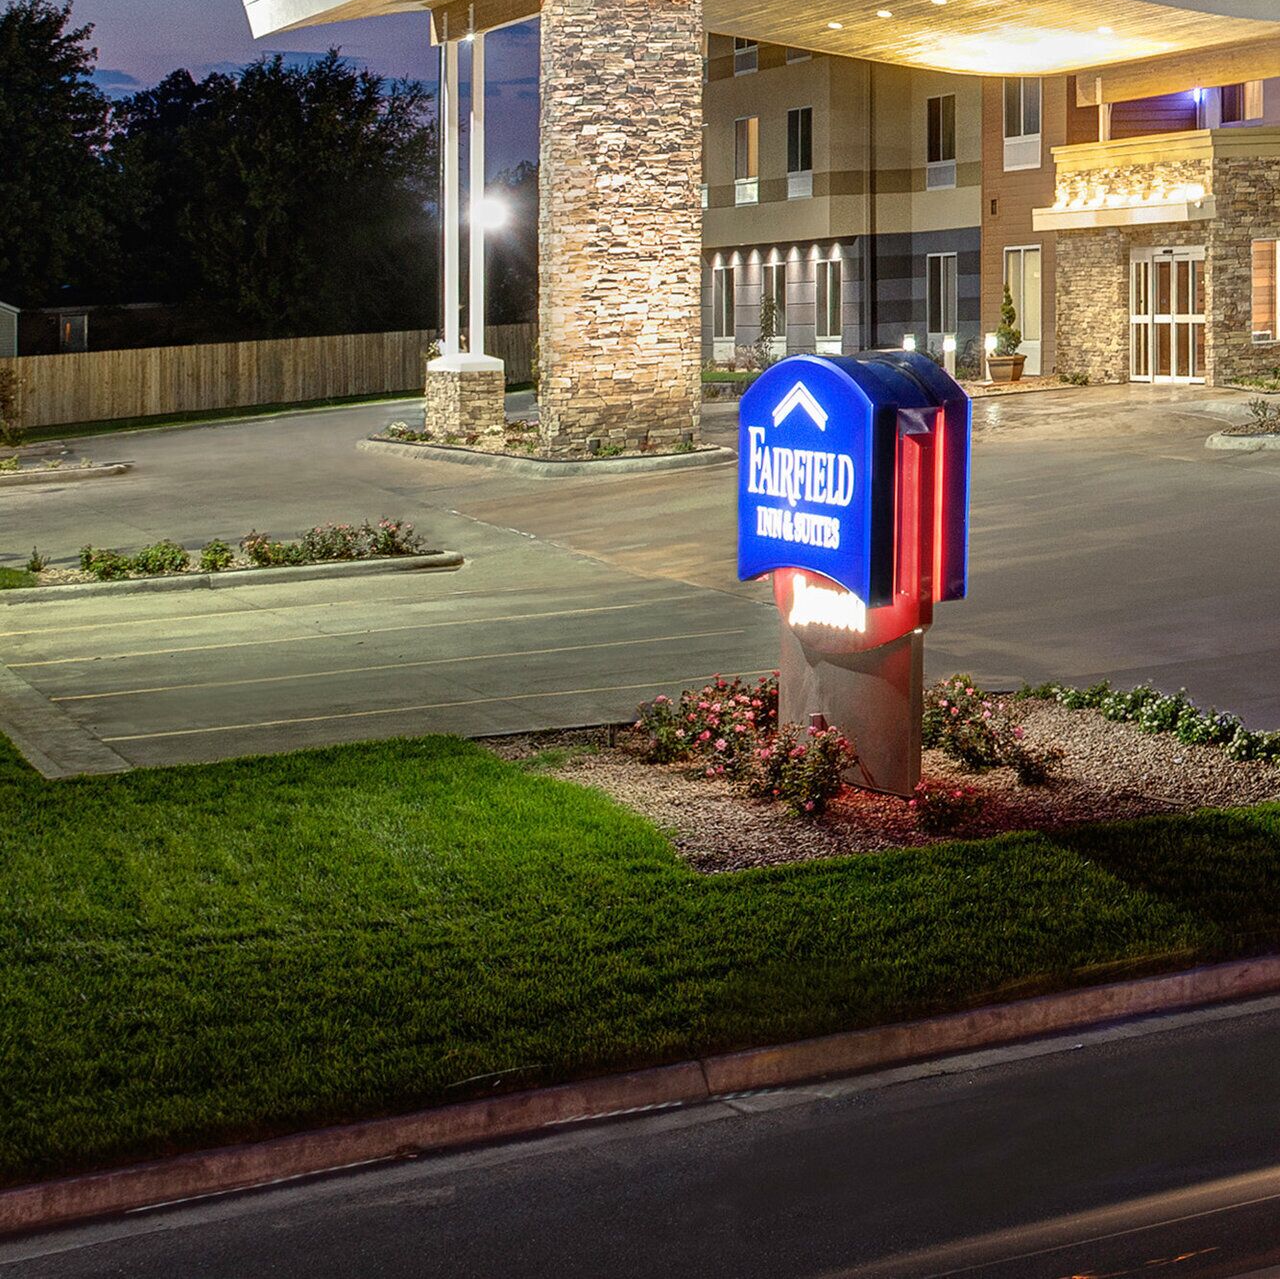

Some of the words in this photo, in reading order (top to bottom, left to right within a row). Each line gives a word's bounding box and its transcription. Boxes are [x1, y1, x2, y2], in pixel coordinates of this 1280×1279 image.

[748, 425, 855, 508] FAIRFIELD
[756, 505, 783, 540] INN
[793, 512, 840, 550] SUITES
